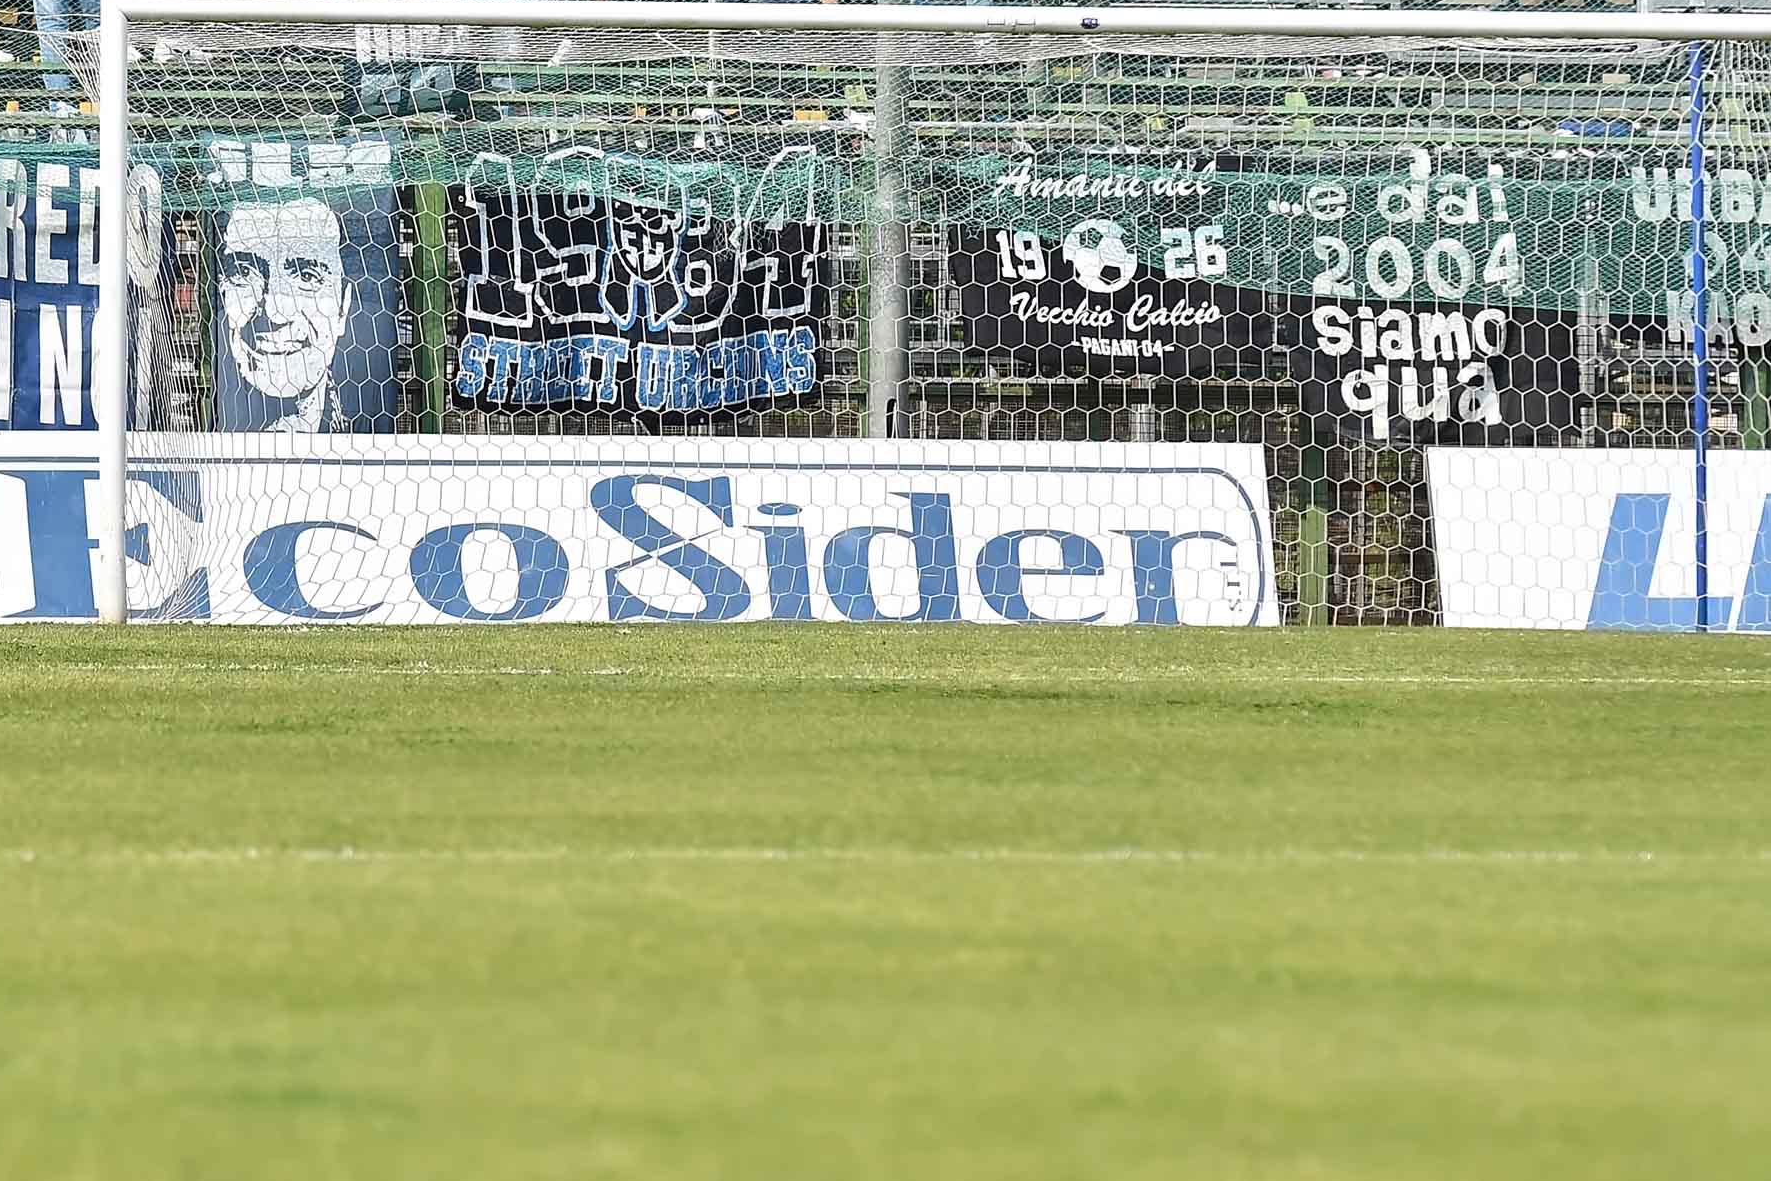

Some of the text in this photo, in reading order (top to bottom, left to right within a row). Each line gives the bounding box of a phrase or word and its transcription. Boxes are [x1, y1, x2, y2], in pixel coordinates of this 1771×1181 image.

[1631, 166, 1771, 223] URB
[995, 224, 1228, 280] 19 26
[1312, 232, 1525, 300] 2004
[1009, 291, 1223, 332] Vecchio Calcio
[39, 303, 151, 431] NI
[455, 332, 630, 405] STREET
[1341, 360, 1503, 440] qua
